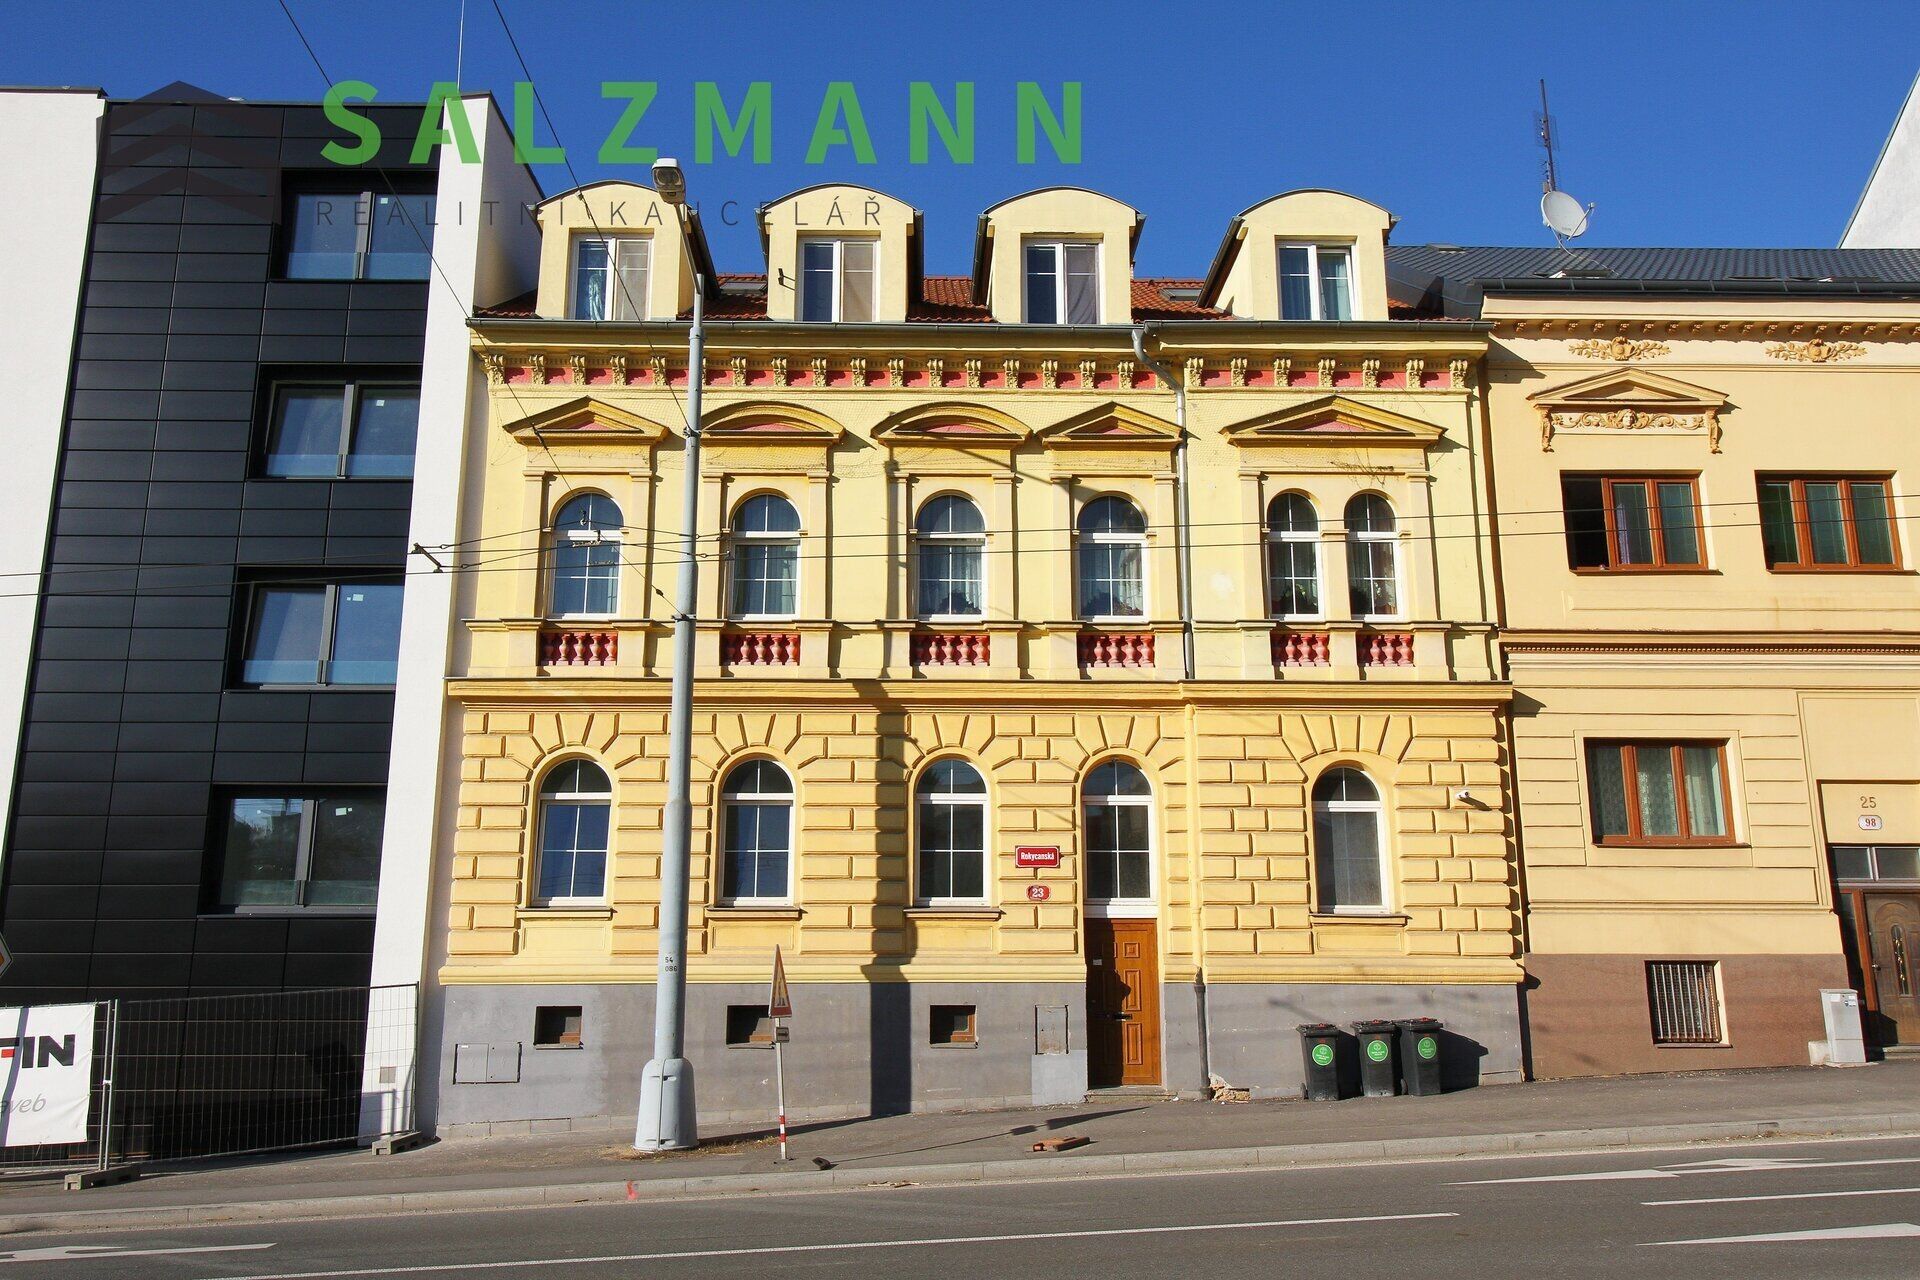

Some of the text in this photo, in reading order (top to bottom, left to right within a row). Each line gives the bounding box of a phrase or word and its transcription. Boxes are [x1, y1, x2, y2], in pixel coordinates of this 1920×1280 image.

[1860, 796, 1877, 808] 25
[1865, 818, 1877, 827] 98
[1032, 888, 1044, 897] 23
